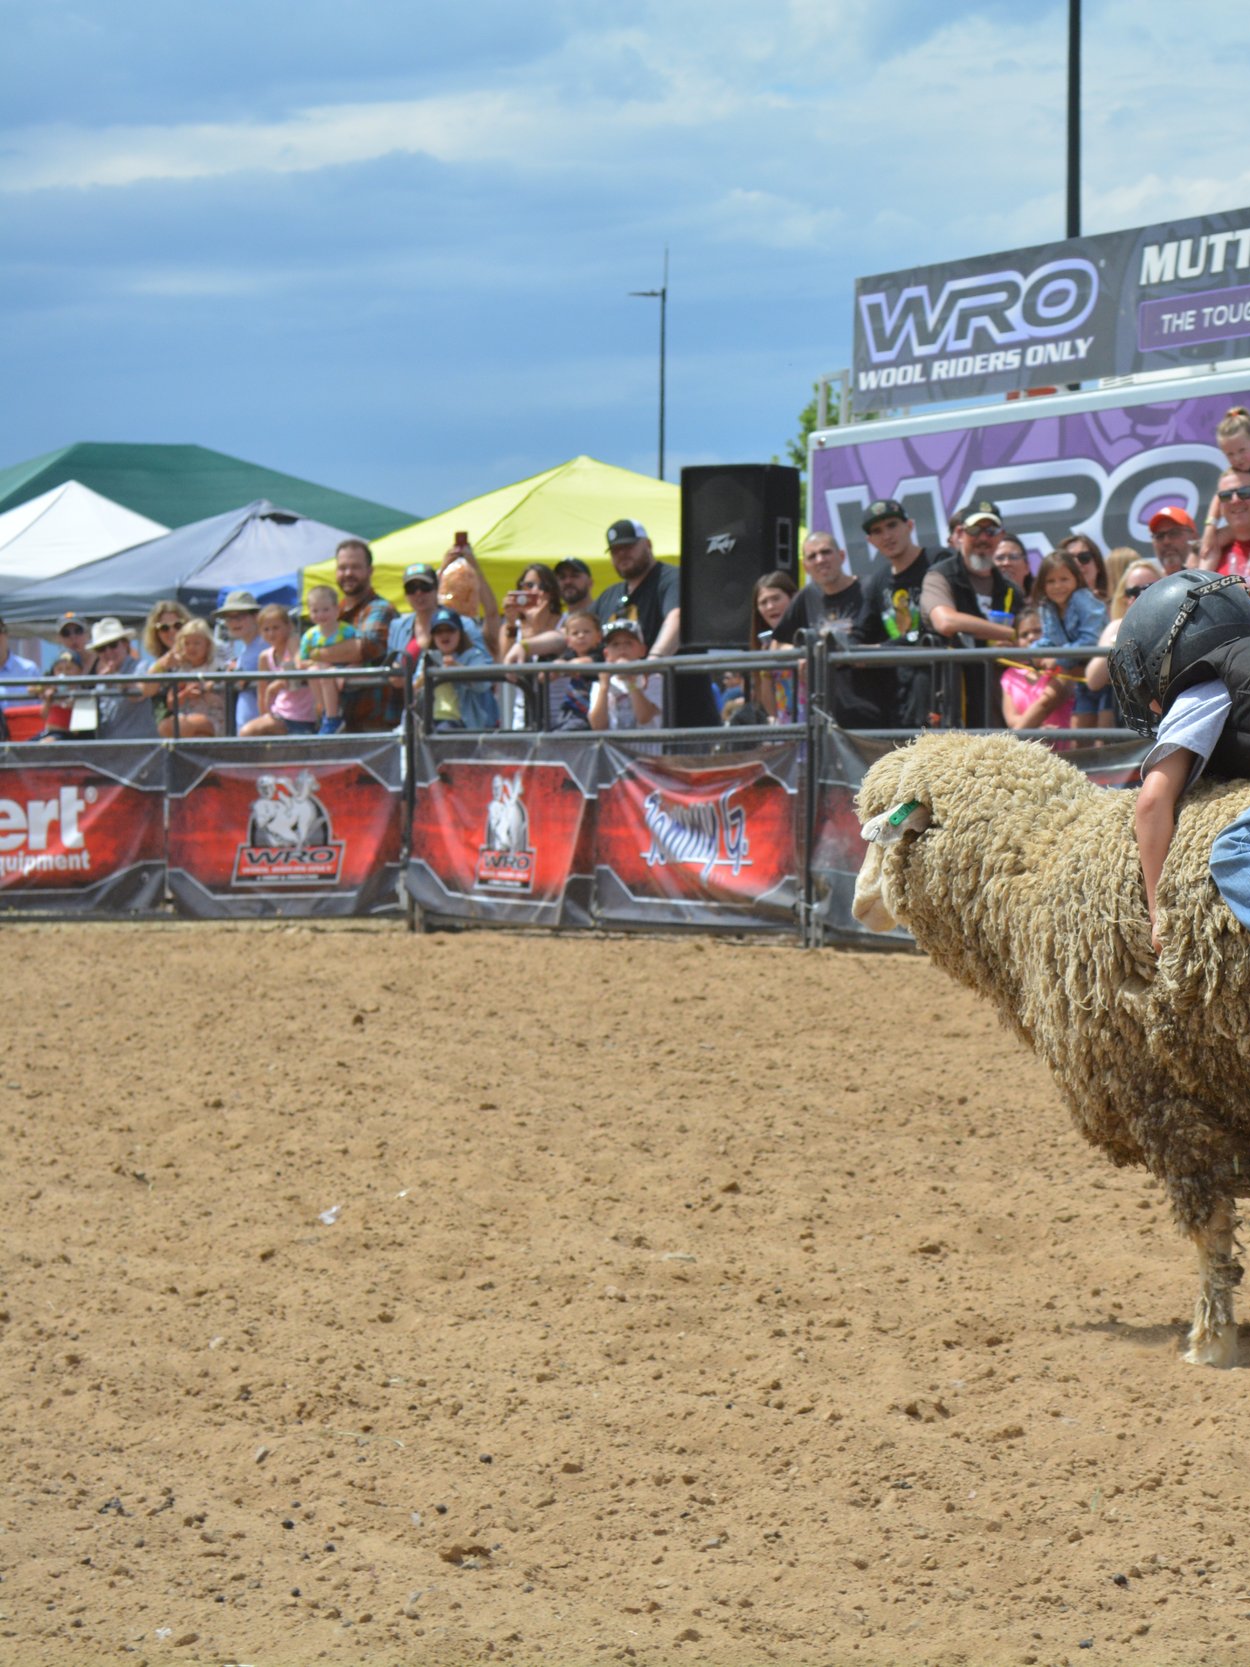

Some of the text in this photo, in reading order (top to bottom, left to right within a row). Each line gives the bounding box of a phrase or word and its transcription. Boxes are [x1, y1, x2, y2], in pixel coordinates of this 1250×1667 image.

[859, 259, 1099, 363] WRO
[1161, 311, 1196, 334] THE
[859, 336, 1095, 391] WOOL RIDERS ONLY
[1200, 575, 1242, 595] TECH
[246, 847, 336, 866] WRO
[482, 852, 531, 870] WRO
